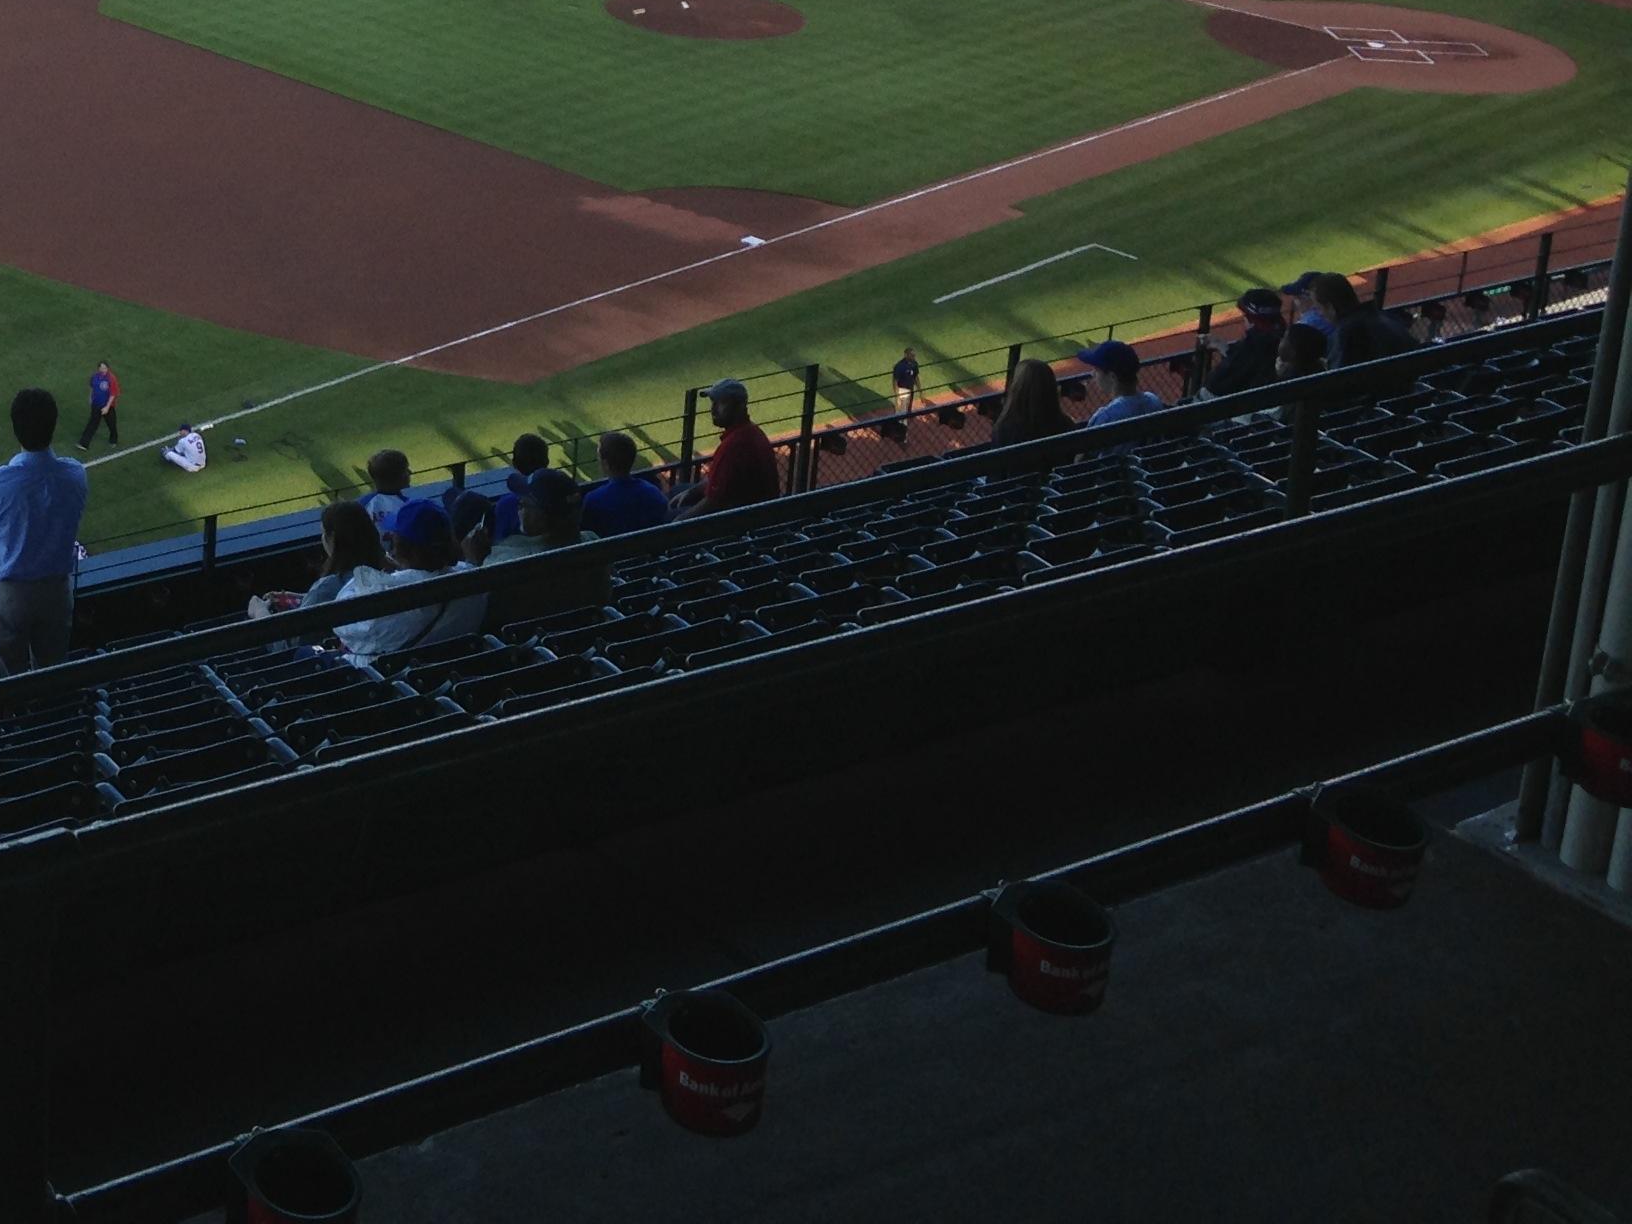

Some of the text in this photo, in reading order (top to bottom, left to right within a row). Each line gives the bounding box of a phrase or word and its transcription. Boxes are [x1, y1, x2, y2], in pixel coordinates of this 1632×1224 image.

[196, 441, 204, 454] 9
[1349, 854, 1388, 877] Bank
[1039, 959, 1080, 979] Bank
[679, 1070, 720, 1097] Bank
